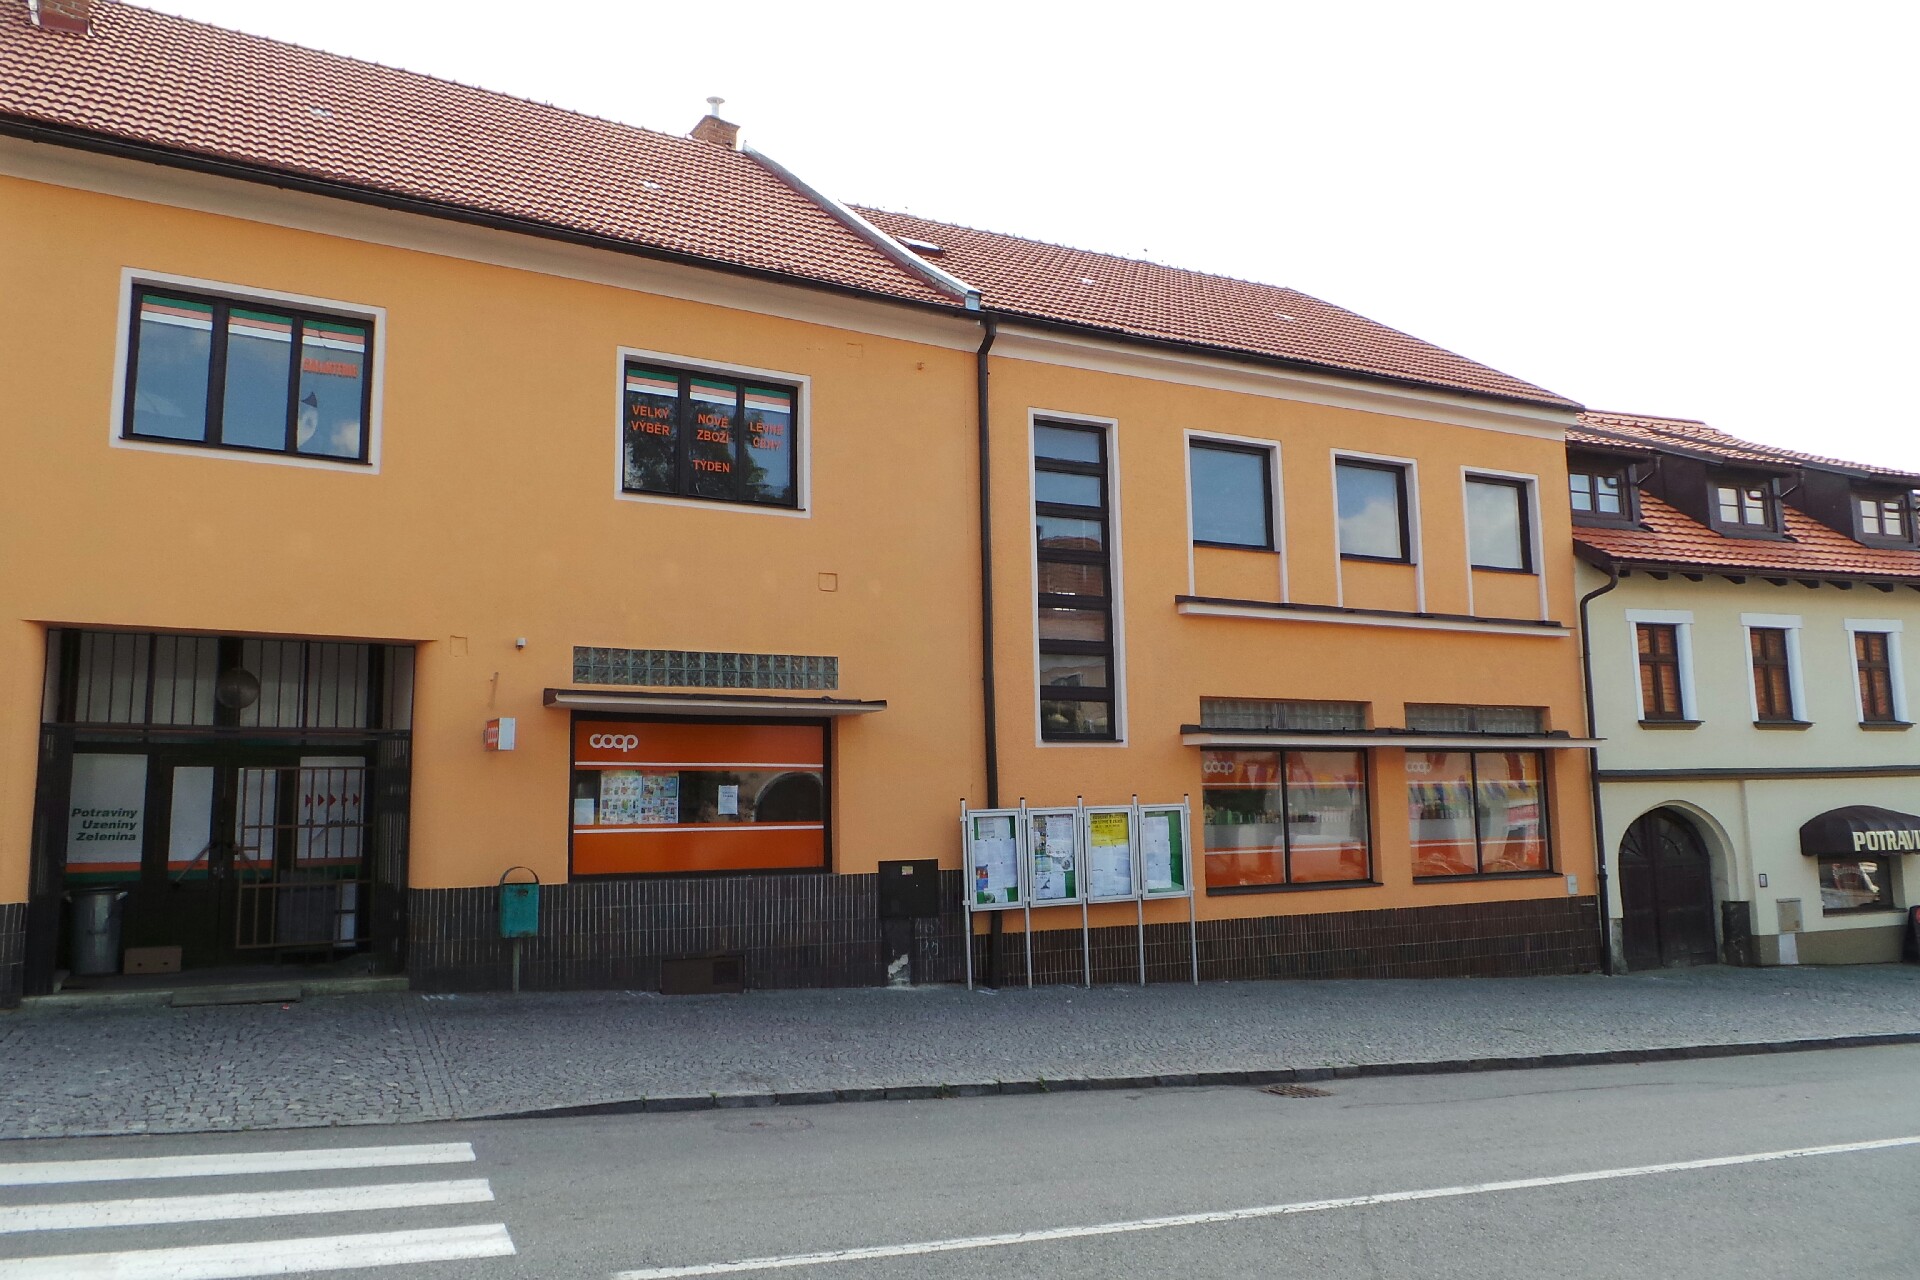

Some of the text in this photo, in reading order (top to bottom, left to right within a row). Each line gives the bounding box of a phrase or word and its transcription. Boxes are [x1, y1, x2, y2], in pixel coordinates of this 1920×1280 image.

[632, 405, 669, 419] VELKÝ
[631, 420, 670, 436] VÝBĚR
[698, 414, 729, 429] NOVÉ
[697, 430, 729, 444] ZBOŽÍ
[693, 459, 730, 473] TÝDEN
[590, 733, 639, 753] coop
[1203, 760, 1234, 775] coop
[1406, 760, 1433, 775] coop
[71, 807, 138, 819] Potraviny
[82, 820, 137, 831] Uzeniny
[75, 832, 137, 841] Zelenina
[1852, 830, 1920, 851] POTRAVI
